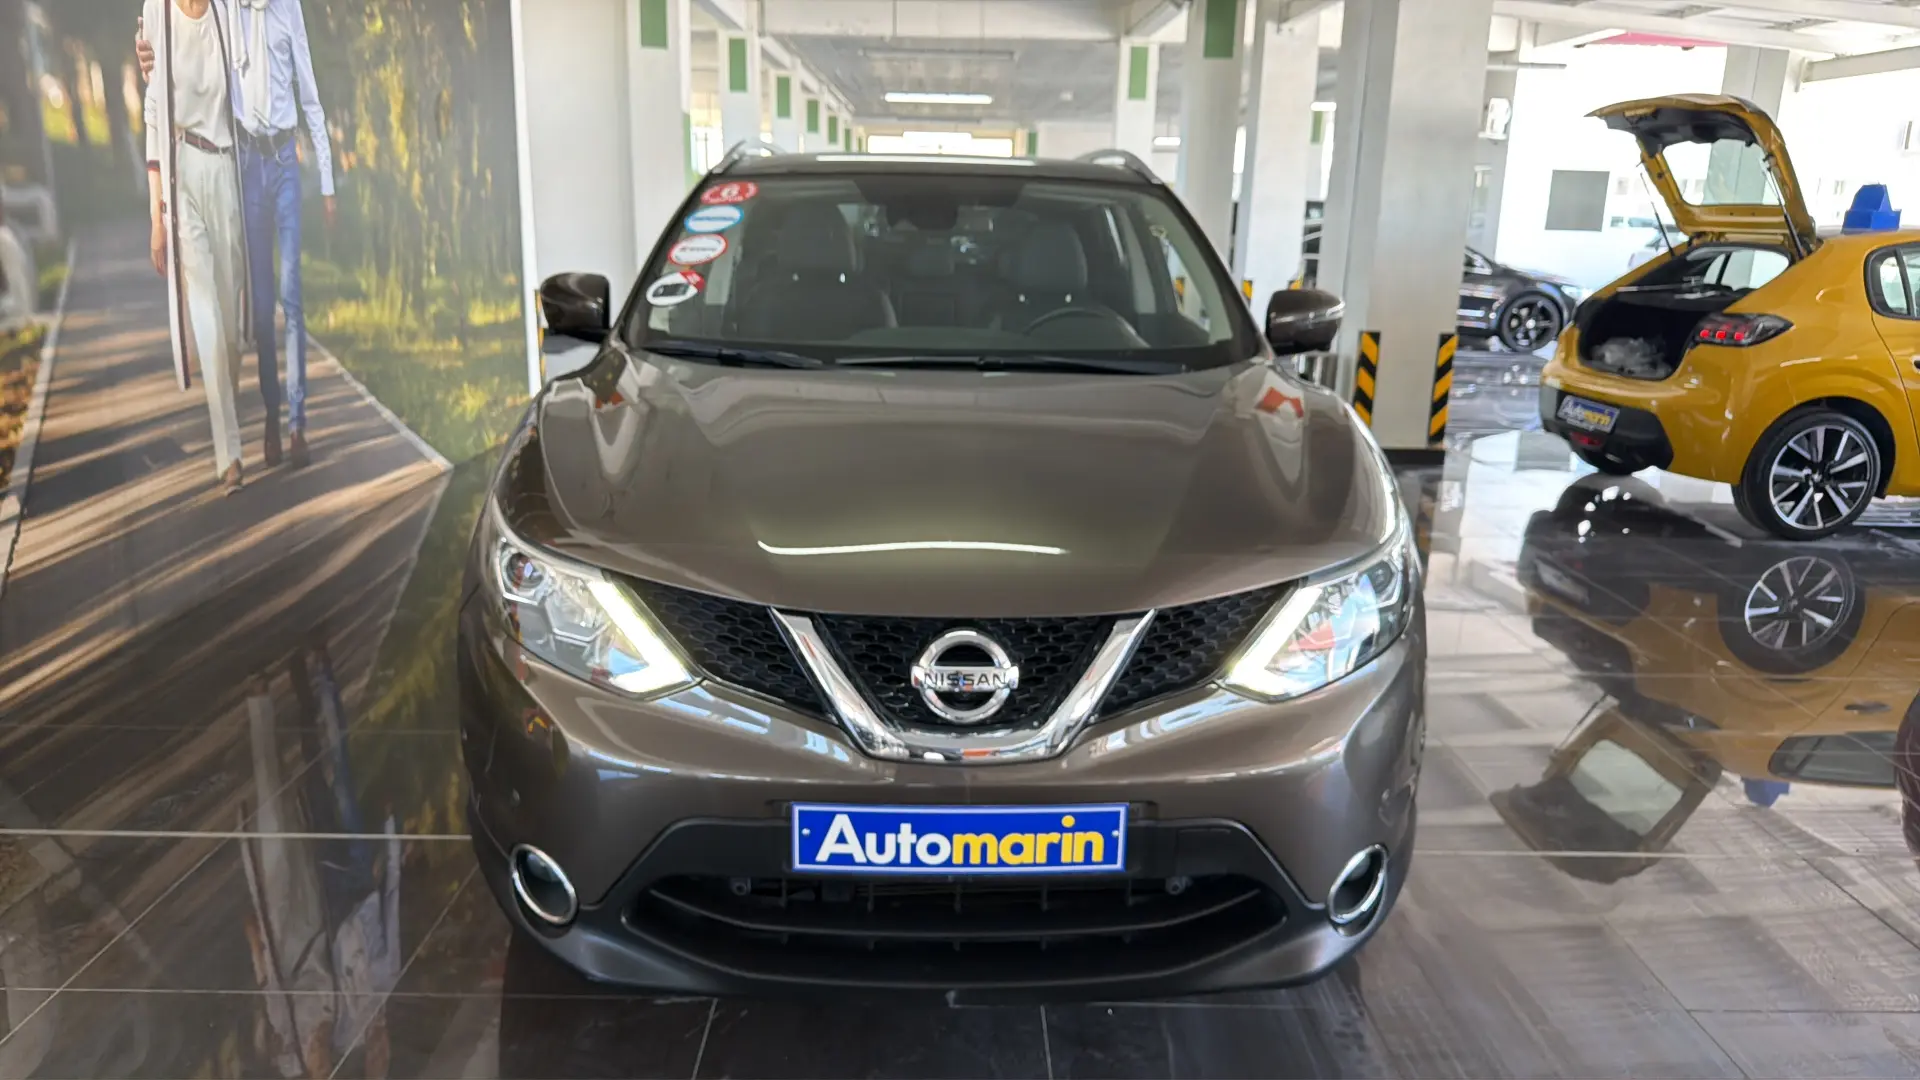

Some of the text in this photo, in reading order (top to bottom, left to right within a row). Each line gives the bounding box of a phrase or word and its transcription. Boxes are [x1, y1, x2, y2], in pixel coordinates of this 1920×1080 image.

[1562, 400, 1612, 426] Automarin
[924, 672, 1006, 686] NISSAN
[815, 813, 1105, 865] Automarin
